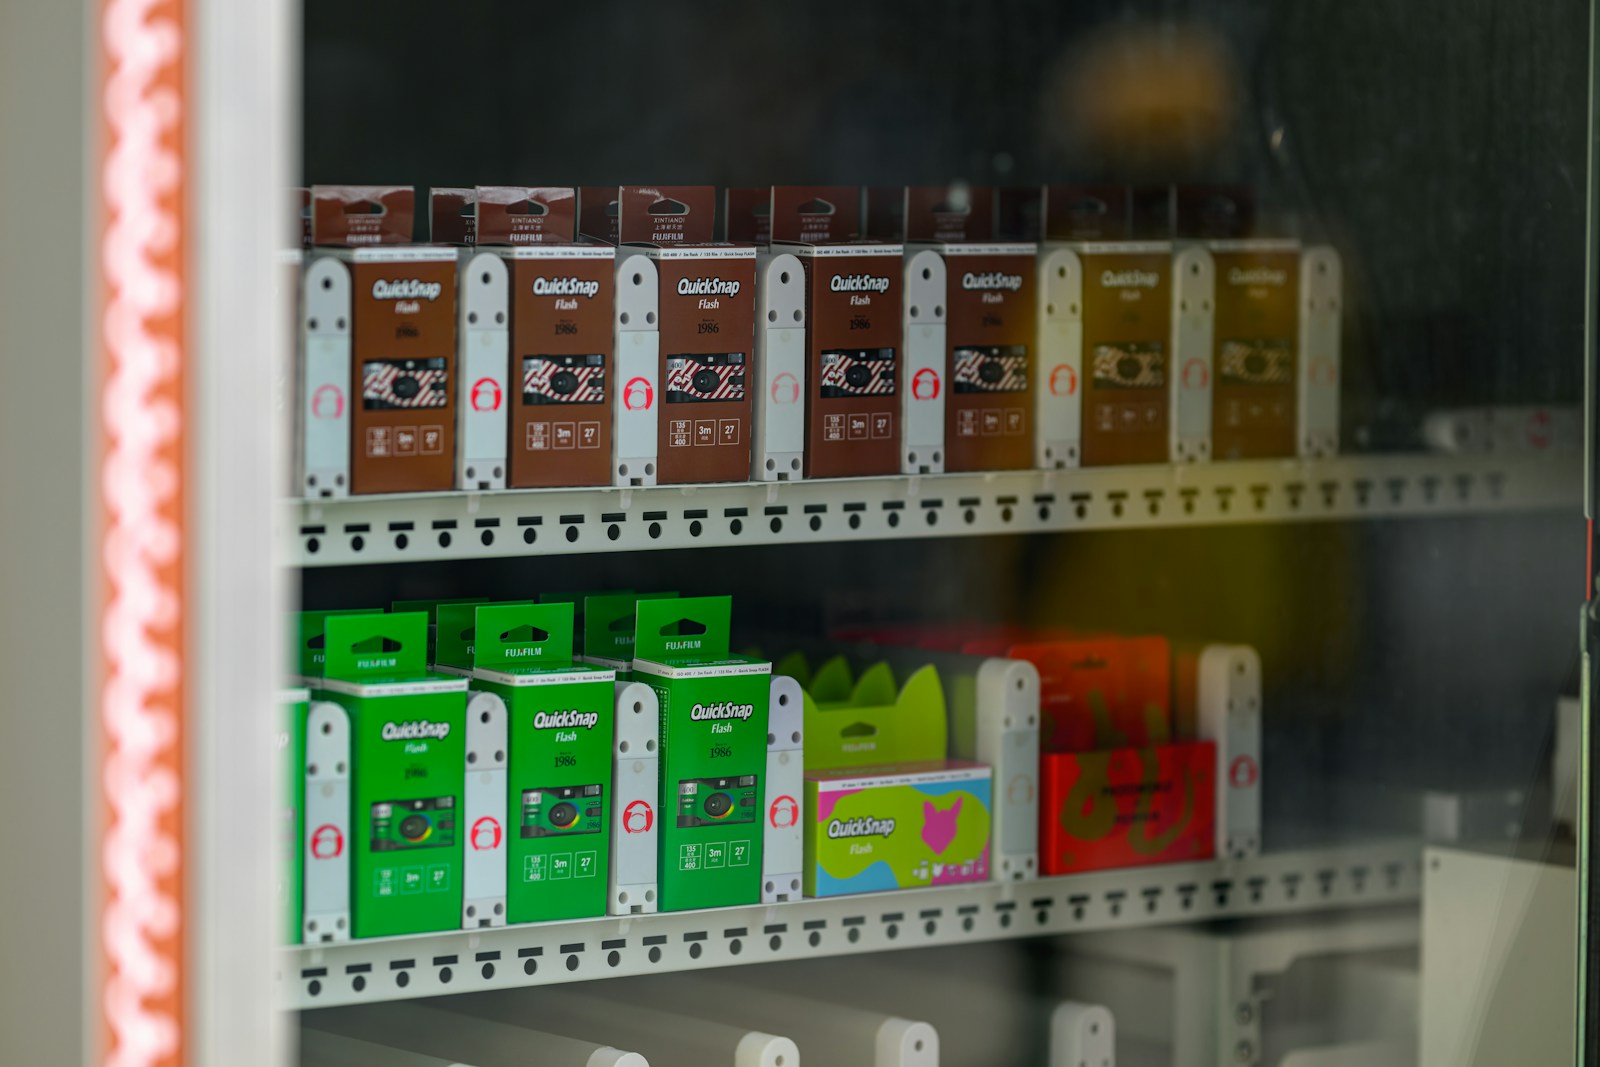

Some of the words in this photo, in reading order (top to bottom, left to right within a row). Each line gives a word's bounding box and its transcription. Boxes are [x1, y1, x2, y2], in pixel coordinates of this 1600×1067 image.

[510, 234, 544, 242] FUJIFILM
[652, 233, 684, 241] FUJIFILM
[533, 277, 599, 298] QuickSnap
[677, 278, 740, 297] QuickSnap
[830, 275, 889, 293] QuickSnap
[963, 273, 1022, 291] QuickSnap
[373, 280, 441, 302] QuickSnap
[555, 299, 578, 310] Flash
[698, 299, 720, 310] Flash
[850, 295, 871, 306] Flash
[555, 323, 577, 335] 1986
[697, 323, 719, 334] 1986
[850, 319, 871, 330] 1986
[670, 361, 682, 369] 400
[852, 420, 865, 429] 3m
[876, 419, 887, 428] 27
[557, 428, 571, 439] 3m
[584, 428, 595, 438] 27
[698, 426, 712, 435] 3m
[724, 425, 735, 435] 27
[674, 438, 686, 446] 400
[665, 640, 701, 650] FUJIFILM
[505, 647, 542, 658] FUJIFILM
[691, 701, 753, 721] QuickSnap
[534, 710, 598, 729] QuickSnap
[382, 720, 450, 741] QuickSnap
[711, 722, 733, 734] Flash
[555, 731, 577, 742] Flash
[710, 746, 732, 759] 1986
[554, 755, 577, 768] 1986
[828, 816, 895, 838] QuickSnap
[708, 848, 722, 858] 3m
[734, 846, 745, 856] 27
[849, 842, 873, 855] Flash
[554, 859, 568, 869] 3m
[580, 857, 591, 867] 27
